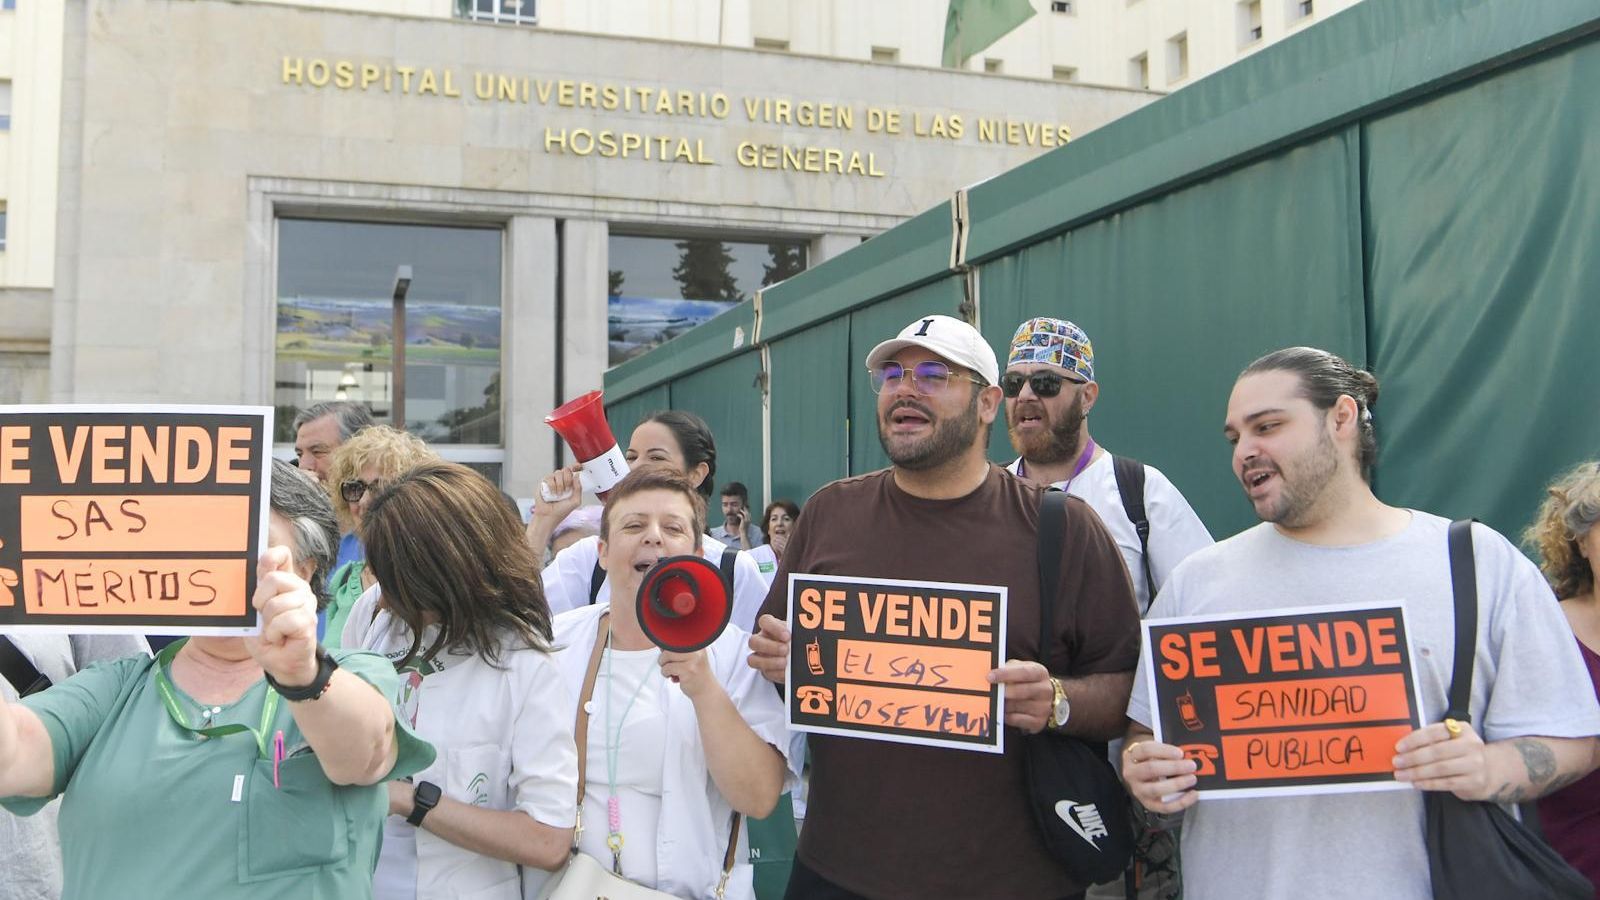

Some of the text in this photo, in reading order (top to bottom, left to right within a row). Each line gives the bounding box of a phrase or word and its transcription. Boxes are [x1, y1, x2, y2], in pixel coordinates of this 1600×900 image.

[281, 55, 1072, 147] HOSPITAL UNIVERSITARIO VIRGEN DE LAS NIEVES
[544, 127, 886, 177] HOSPITAL GENERAL
[0, 425, 252, 484] E VENDE
[51, 498, 147, 540] SAS
[34, 562, 217, 608] MÉRITOS
[798, 588, 993, 644] SE VENDE
[843, 648, 875, 675] EL
[1159, 616, 1402, 681] SE VENDE
[836, 693, 872, 720] NO
[877, 702, 918, 726] SE
[1231, 684, 1367, 721] SANIDAD
[1246, 735, 1364, 770] PUBLICA
[1073, 803, 1109, 841] NIKE
